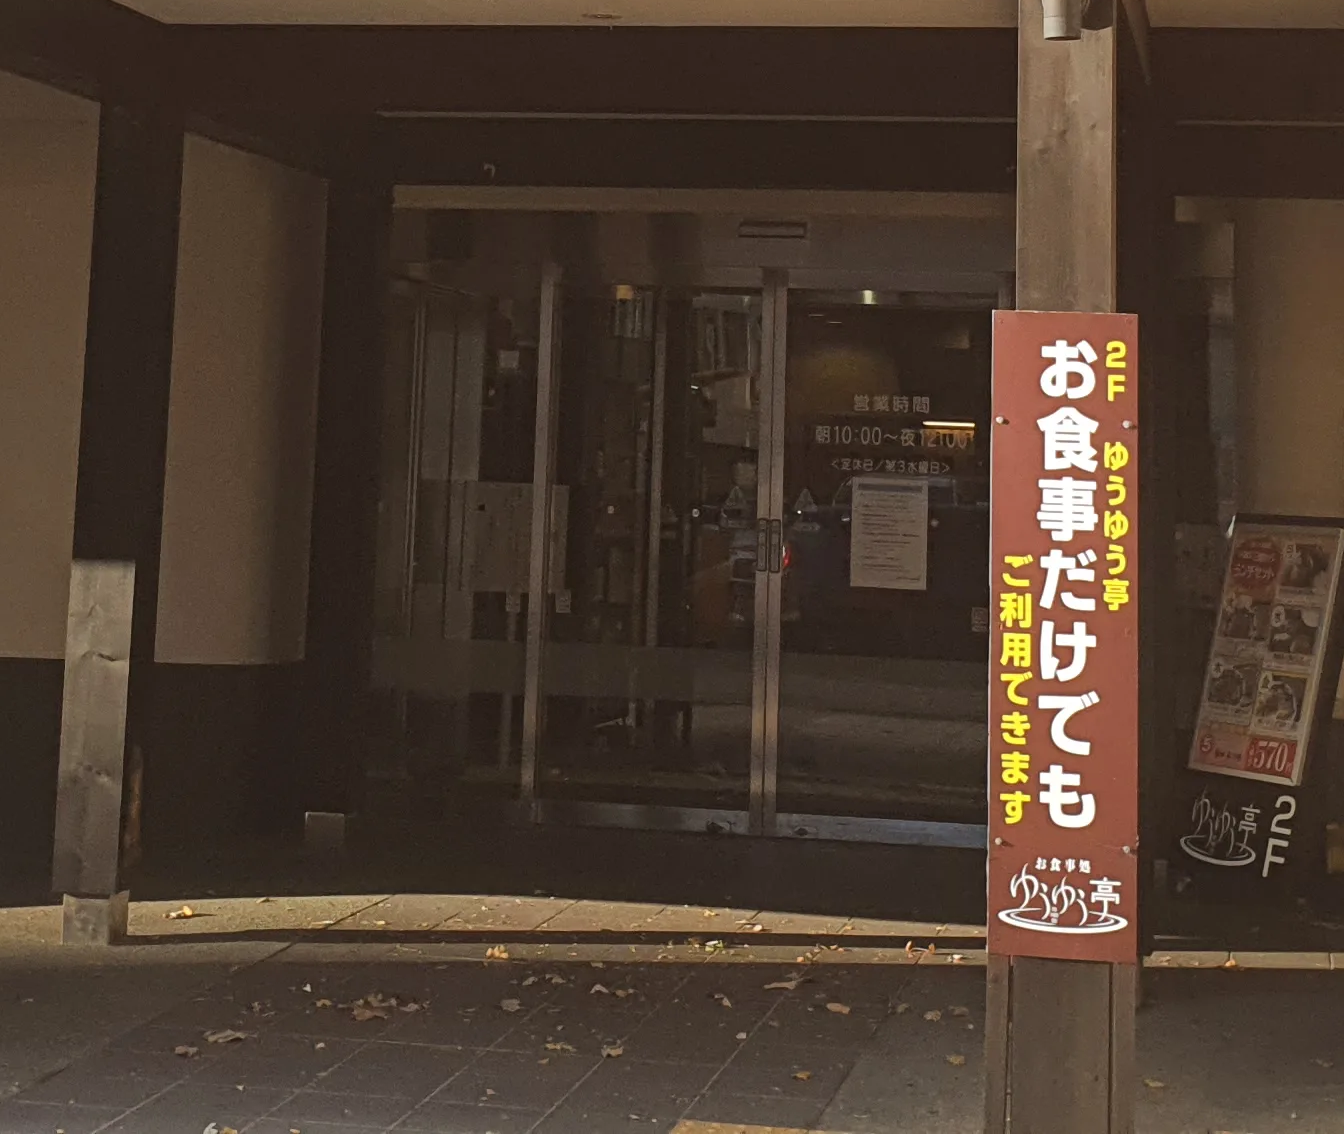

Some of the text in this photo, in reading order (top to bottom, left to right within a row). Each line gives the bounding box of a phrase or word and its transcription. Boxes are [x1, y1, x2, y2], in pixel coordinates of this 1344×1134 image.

[853, 393, 931, 414] 営業時間
[1102, 340, 1130, 612] 2F ゆうゆう亭
[1036, 338, 1100, 830] お食事だけでも
[998, 554, 1034, 826] ご利用できます
[1034, 856, 1091, 874] お食事処
[1261, 794, 1297, 879] 2F
[1009, 862, 1122, 926] ゆうゆう亭
